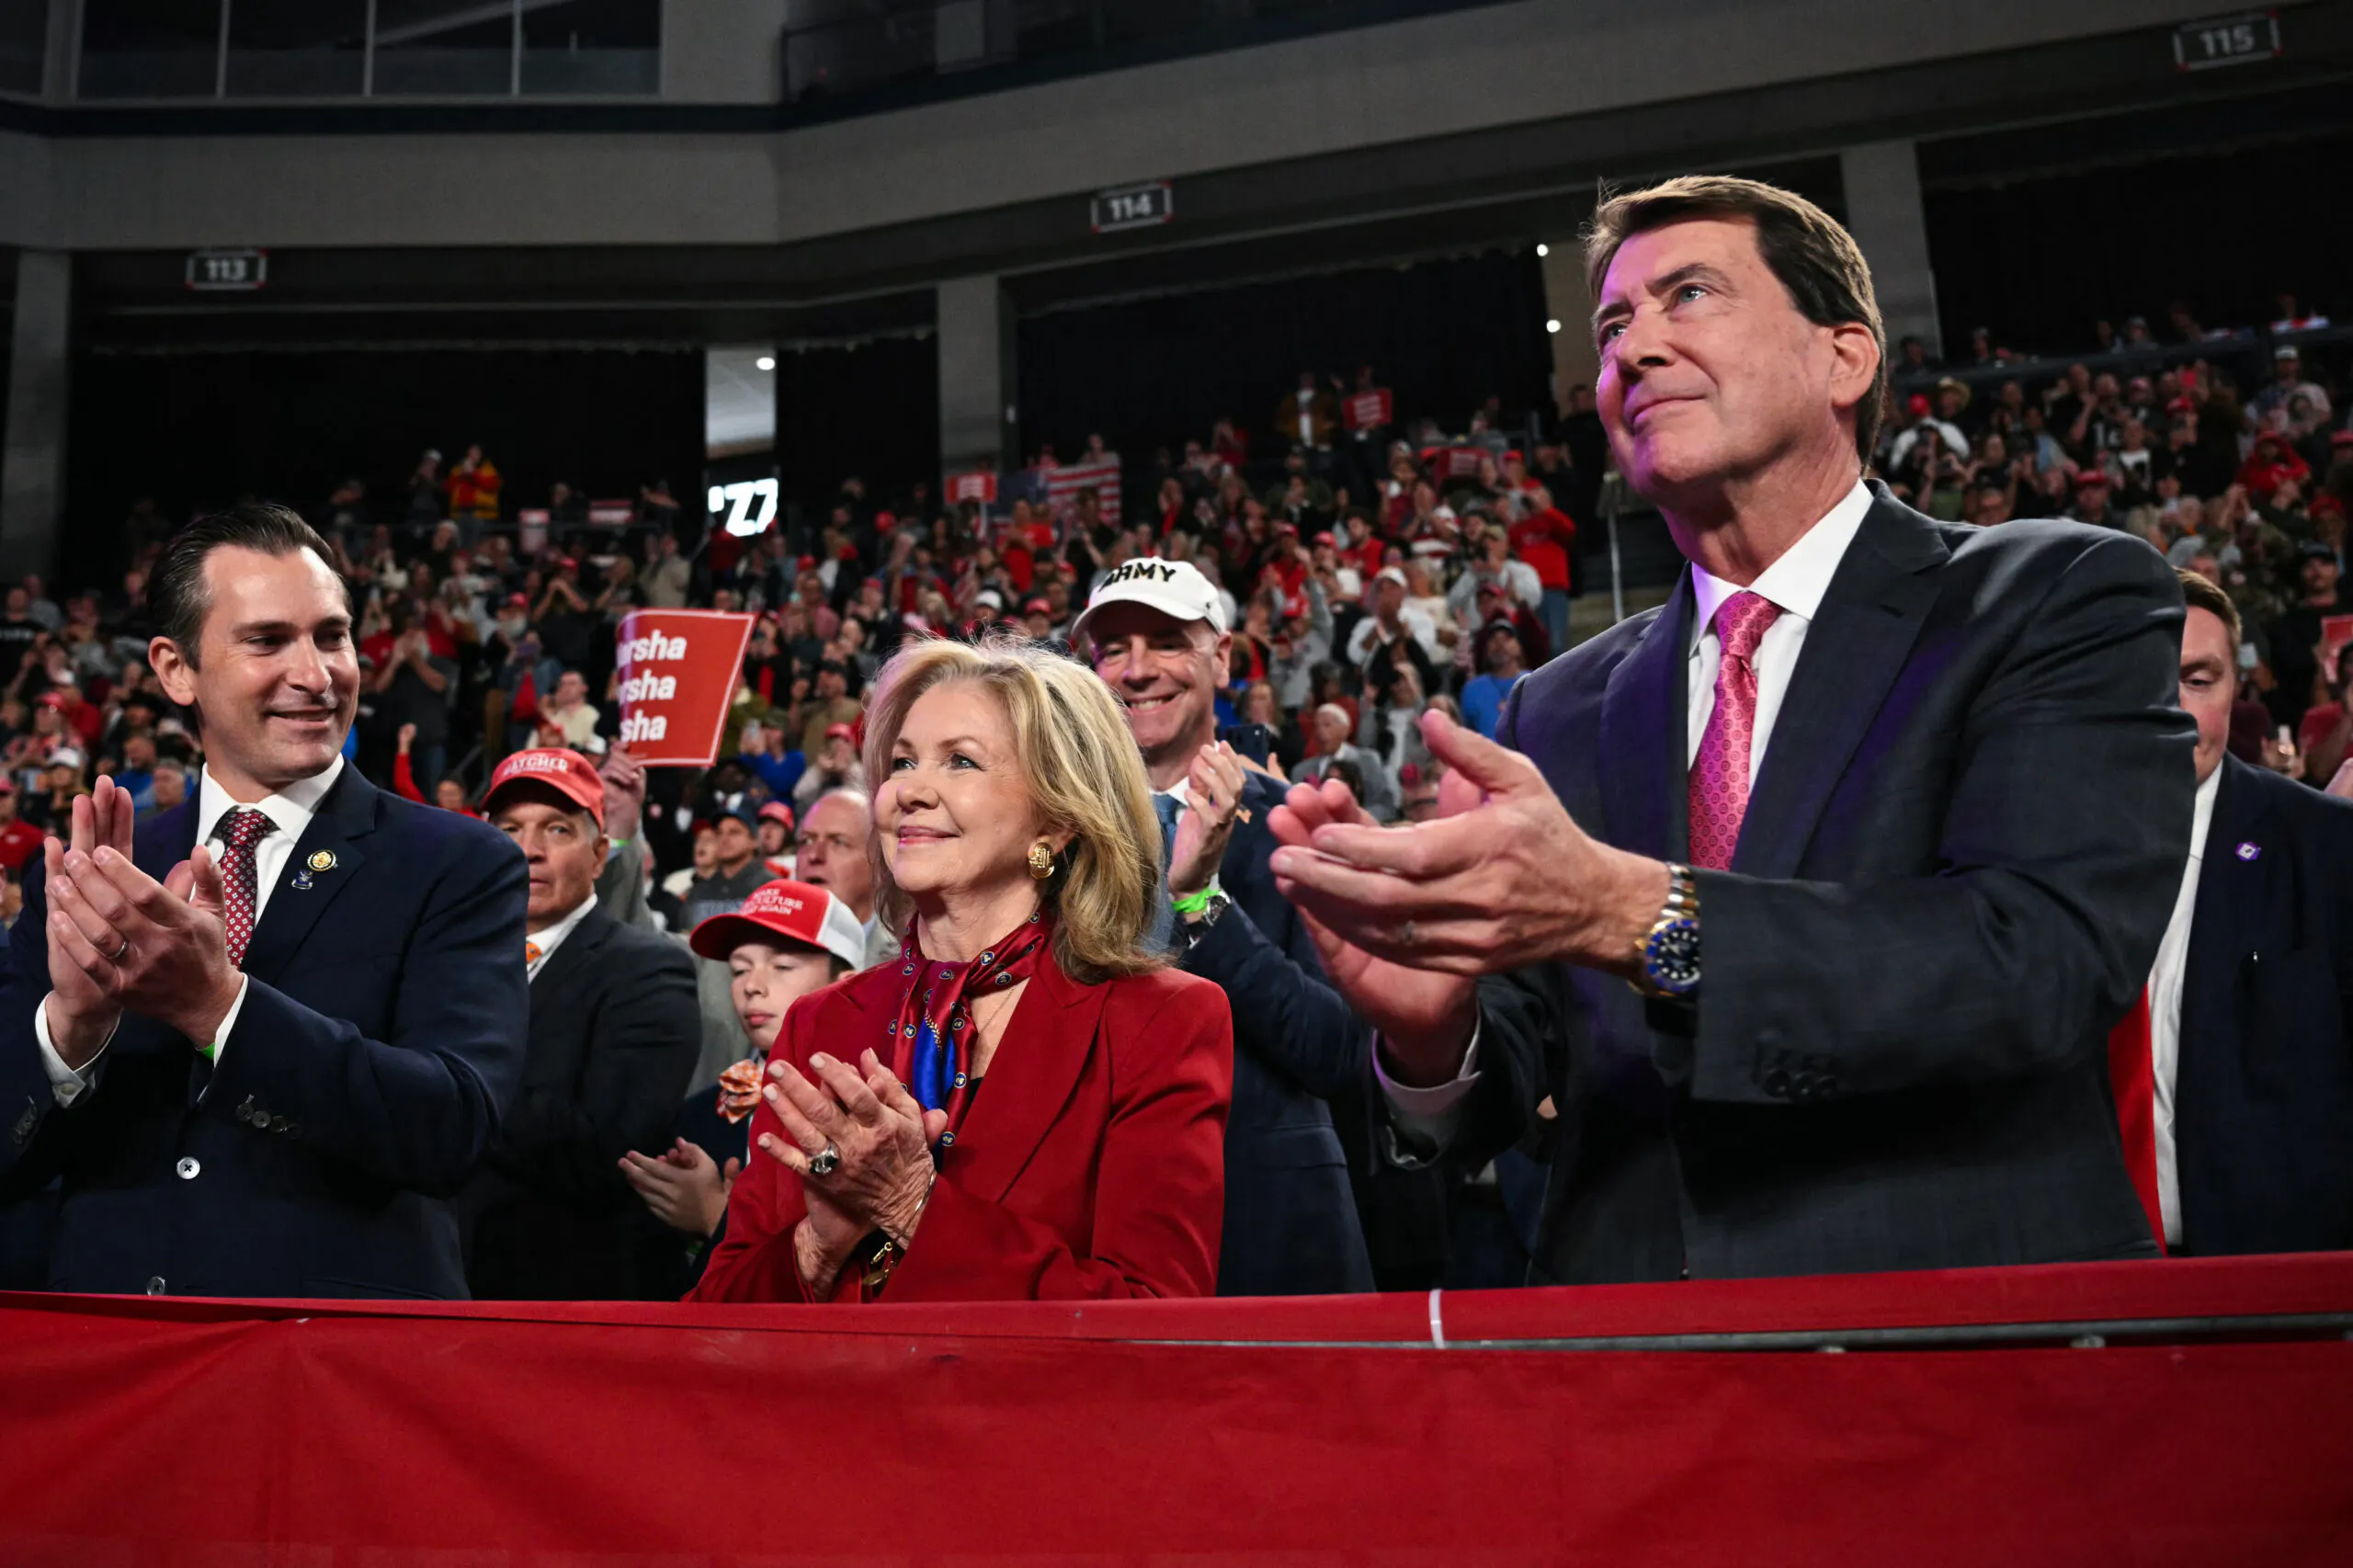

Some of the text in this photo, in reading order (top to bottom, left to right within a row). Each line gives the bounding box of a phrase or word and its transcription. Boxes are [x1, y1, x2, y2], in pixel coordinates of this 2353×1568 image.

[2199, 24, 2256, 57] 115
[1108, 194, 1153, 221] 114
[205, 259, 246, 280] 113
